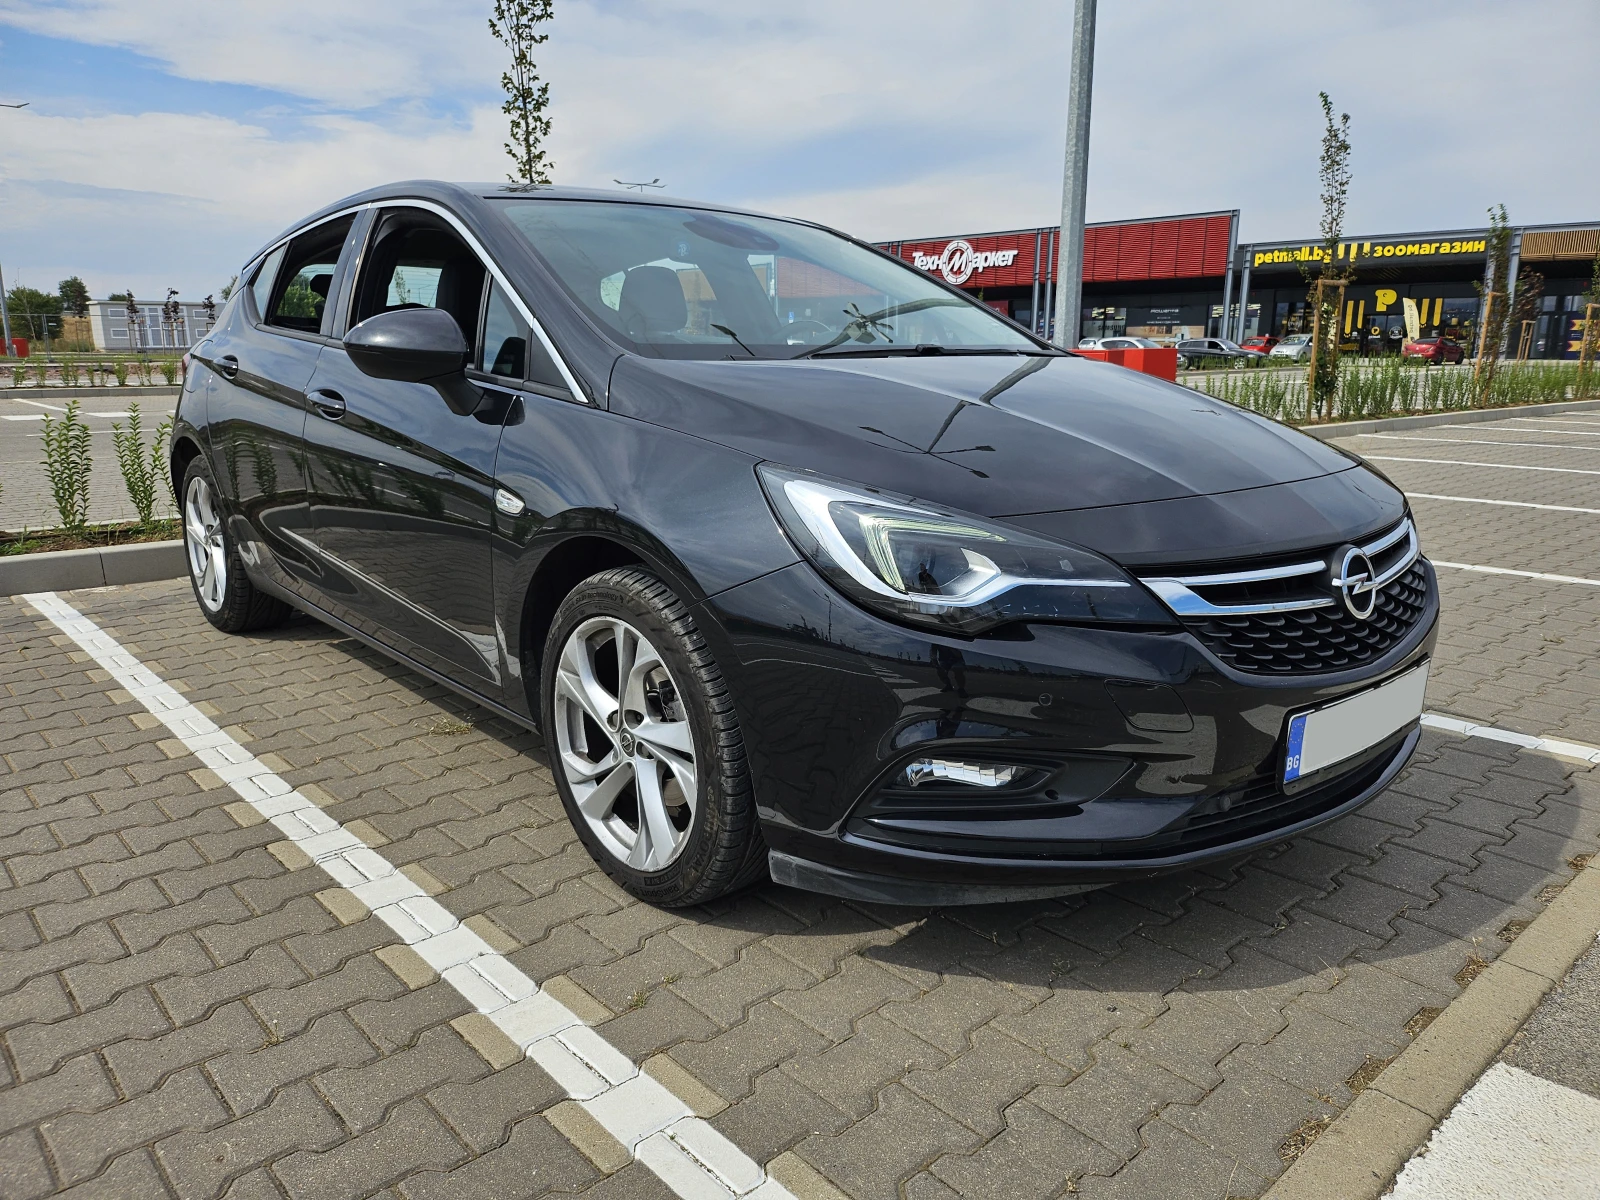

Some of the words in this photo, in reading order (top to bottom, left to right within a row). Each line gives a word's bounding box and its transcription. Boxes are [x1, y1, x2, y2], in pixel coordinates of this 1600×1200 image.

[1254, 246, 1333, 267] petmall.bg
[1373, 240, 1486, 257] зоомагазин
[1286, 753, 1300, 771] BG
